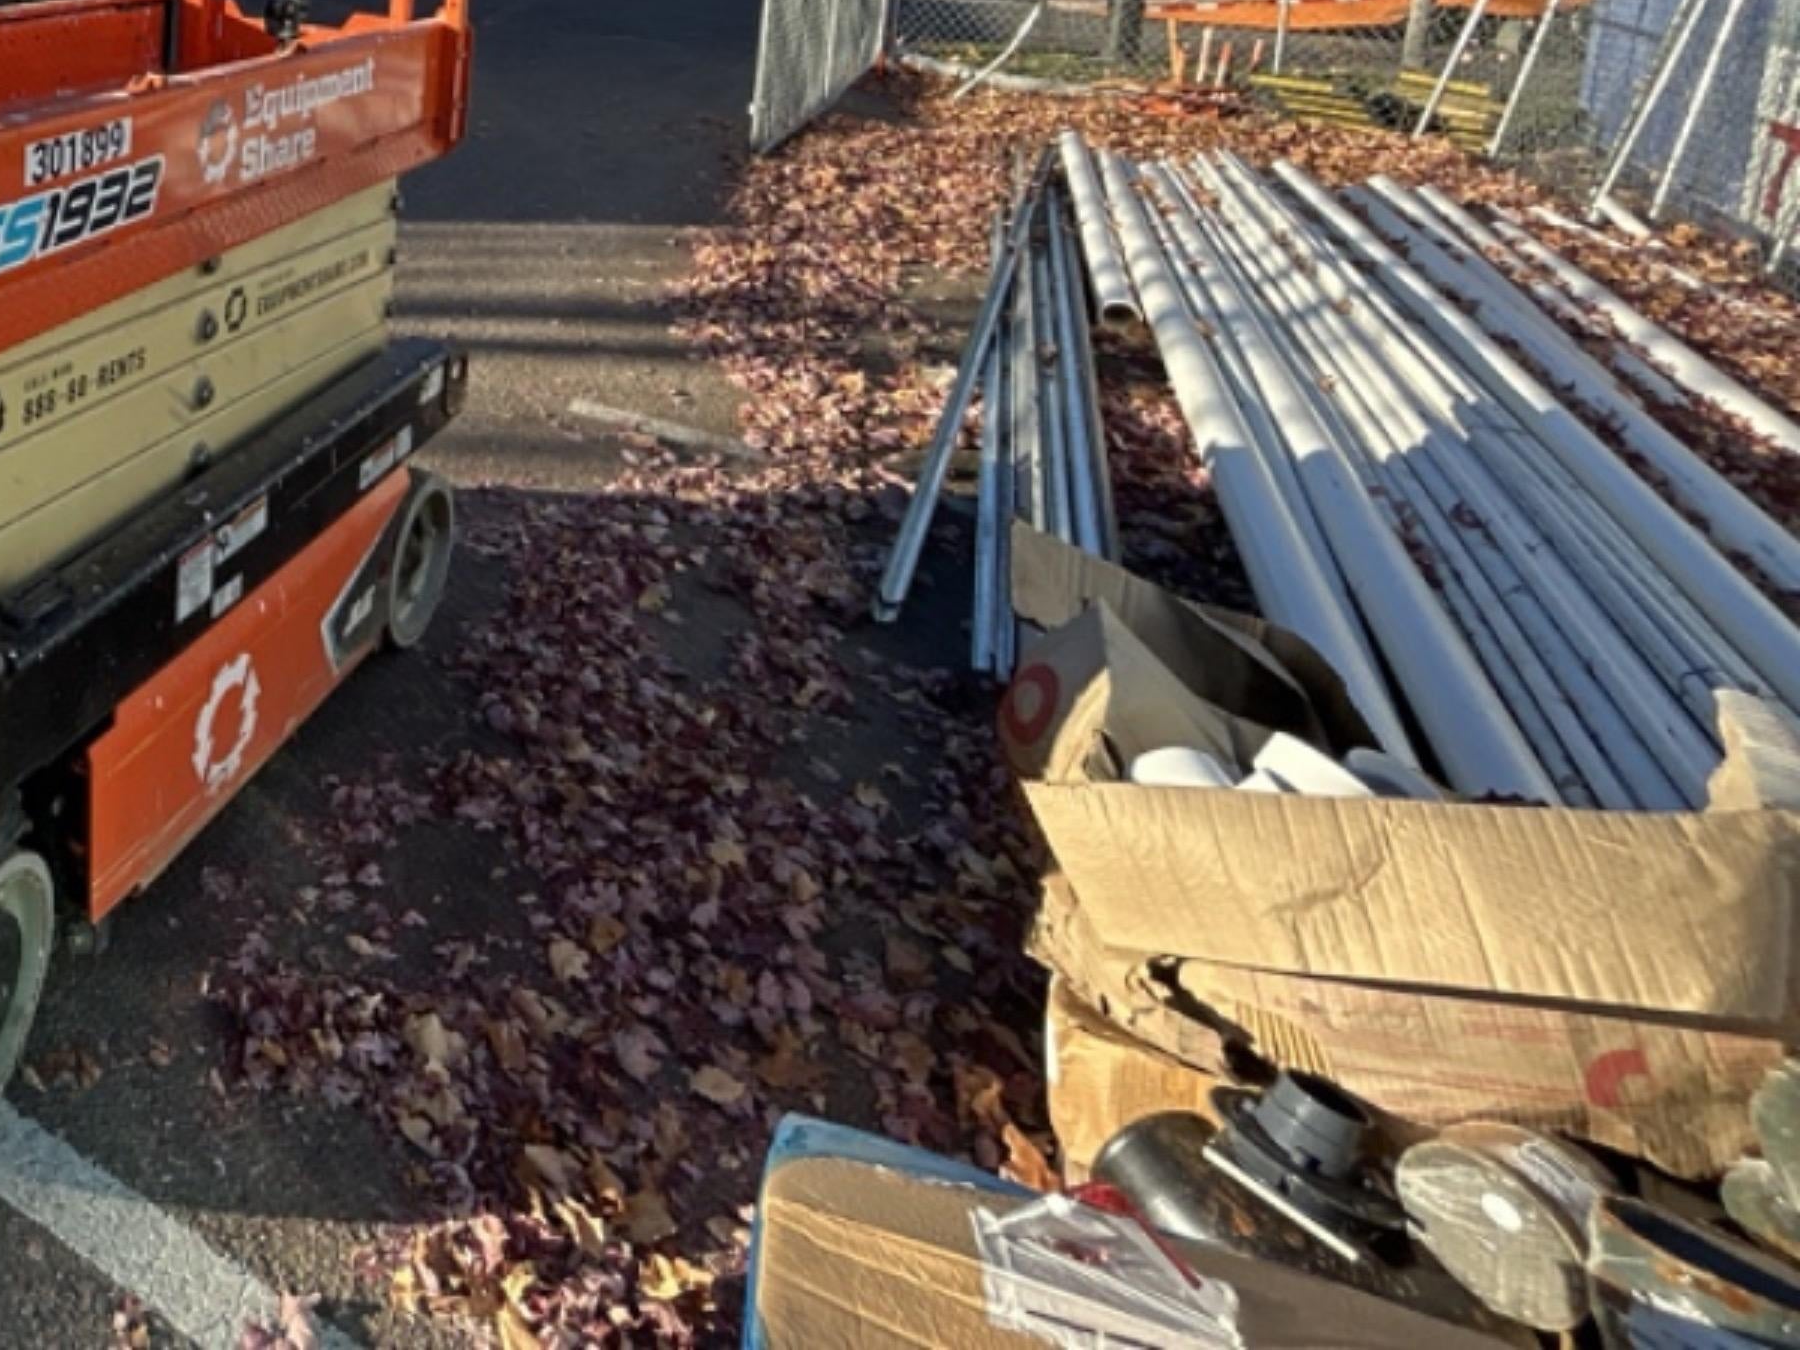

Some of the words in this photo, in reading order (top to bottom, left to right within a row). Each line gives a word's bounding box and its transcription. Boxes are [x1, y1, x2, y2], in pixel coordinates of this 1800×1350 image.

[243, 55, 375, 130] Equipment
[31, 121, 124, 184] 301899
[238, 126, 317, 184] Share
